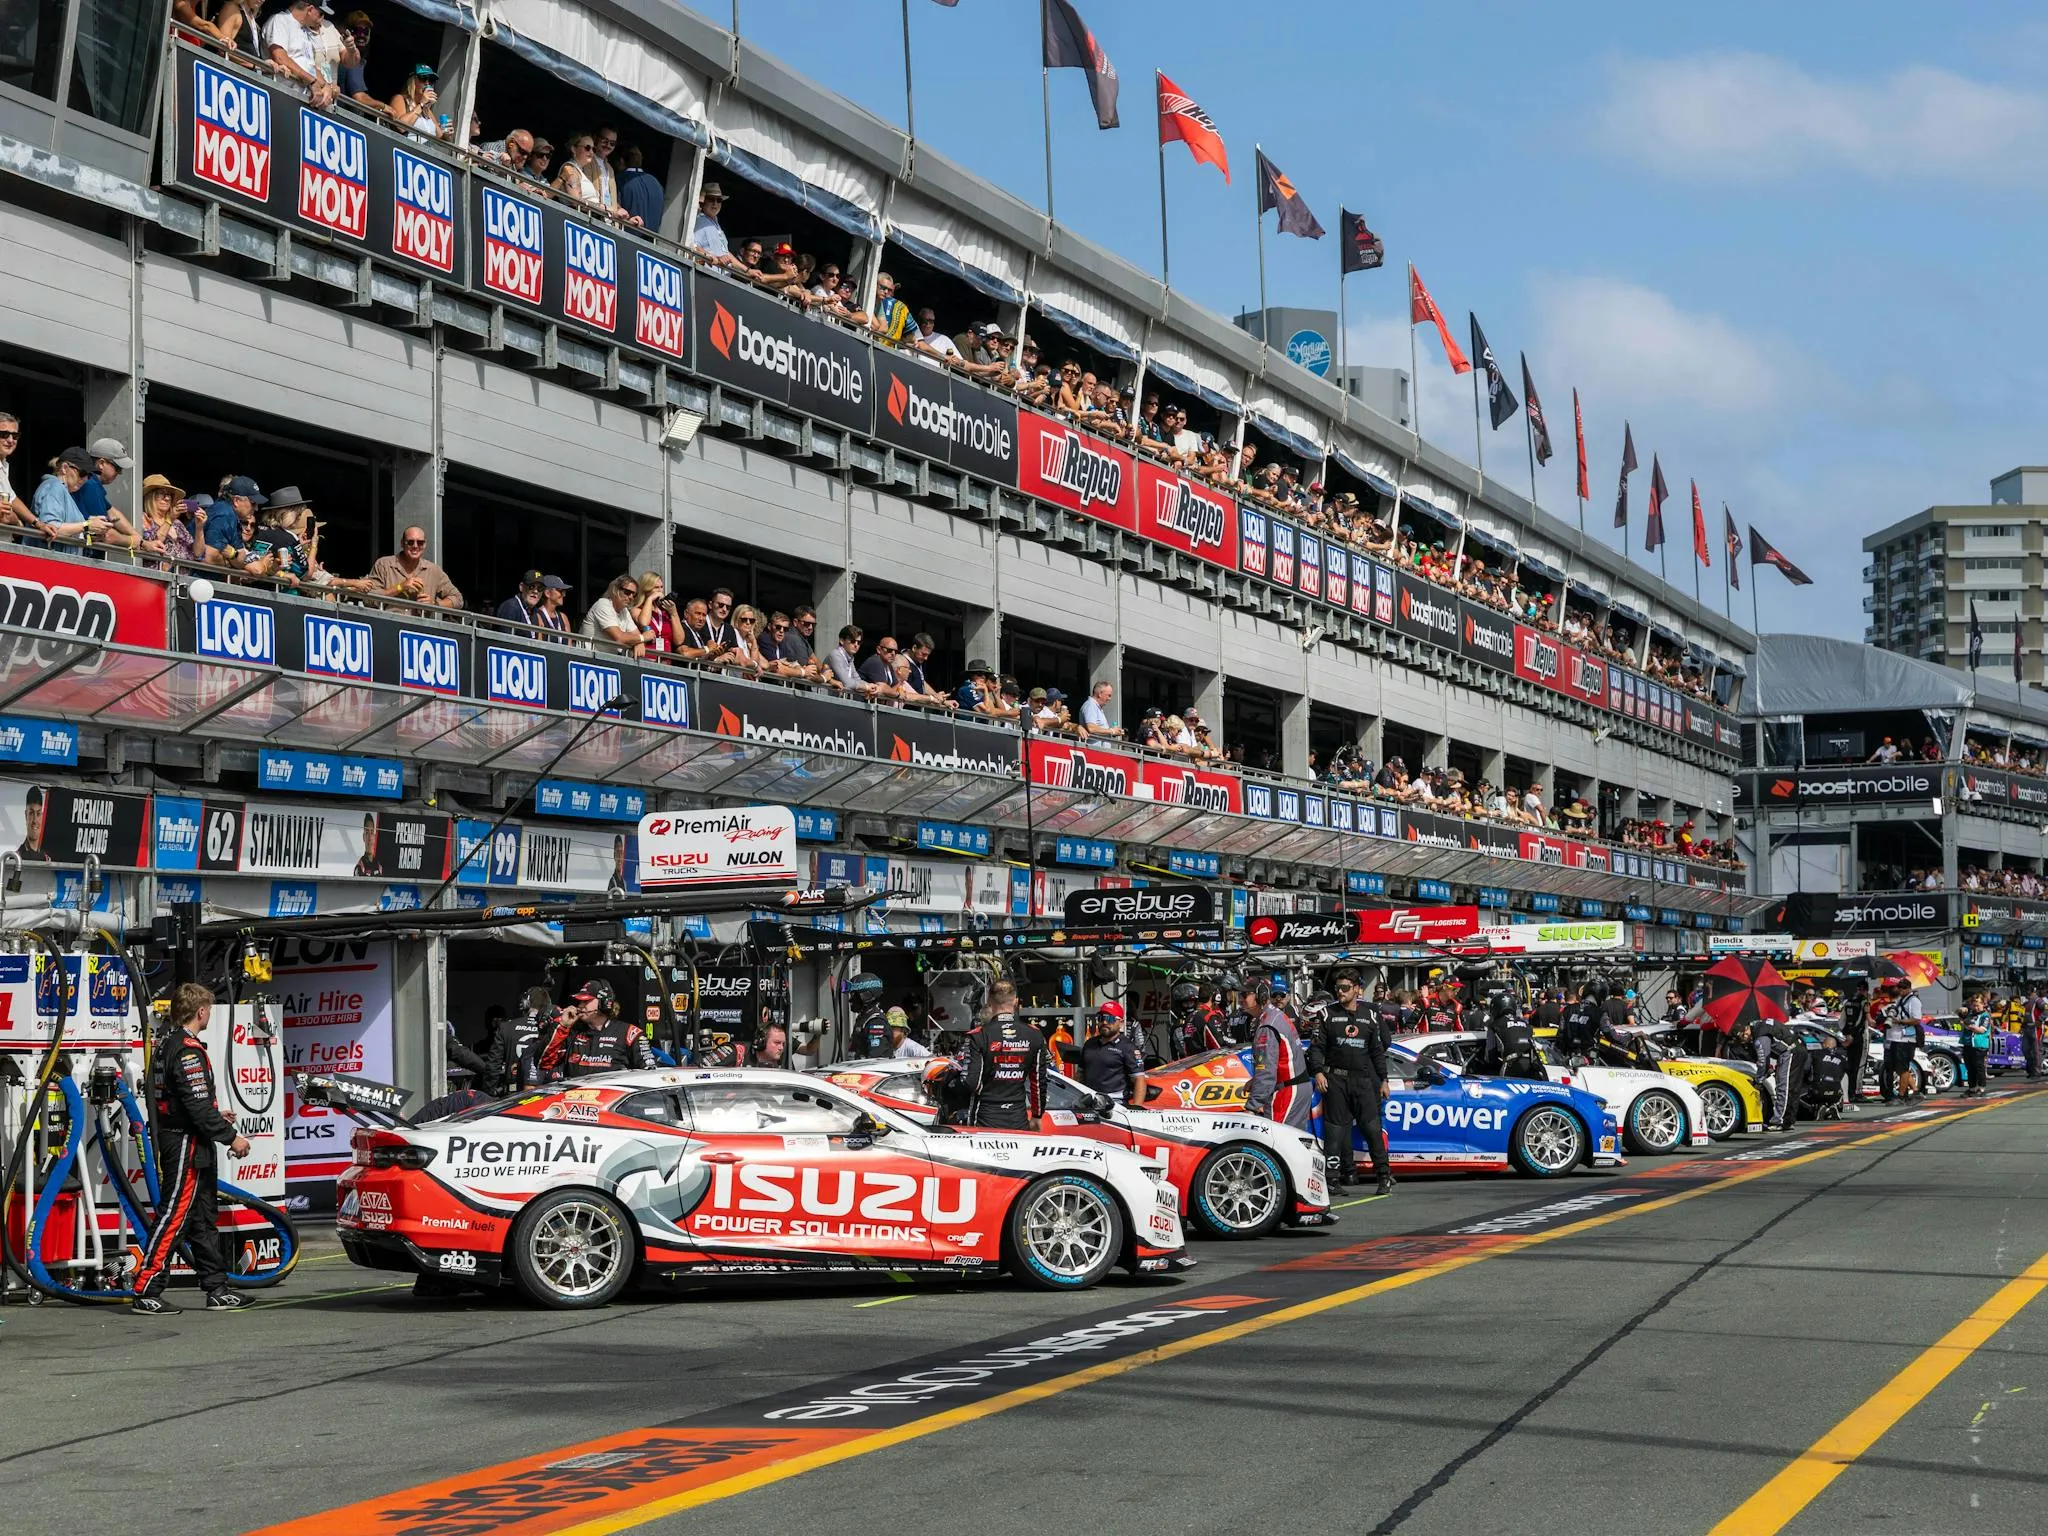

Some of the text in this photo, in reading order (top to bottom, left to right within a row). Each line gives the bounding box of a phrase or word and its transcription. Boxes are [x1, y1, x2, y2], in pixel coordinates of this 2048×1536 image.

[199, 62, 268, 140] LIQUI
[198, 125, 268, 193] MOLY
[303, 115, 365, 181] LIQUI
[397, 155, 451, 216] LIQUI
[302, 167, 365, 233] MOLY
[396, 205, 451, 266] MOLY
[486, 193, 541, 252] LIQUI
[567, 225, 615, 280] LIQUI
[486, 243, 541, 299] MOLY
[639, 256, 682, 308] LIQUI
[567, 272, 615, 327] MOLY
[639, 301, 682, 353] MOLY
[738, 315, 862, 404] boostmobile
[908, 397, 1011, 460] boostmobile
[1064, 433, 1121, 506] Repco
[1177, 480, 1224, 546] Repco
[1244, 512, 1266, 546] LIQUI
[1274, 525, 1293, 556] LIQUI
[1245, 540, 1266, 573] MOLY
[1301, 537, 1319, 566] LIQUI
[1329, 548, 1346, 576] LIQUI
[1275, 551, 1293, 584] MOLY
[1301, 562, 1319, 594] MOLY
[1353, 558, 1369, 587] LIQUI
[1329, 571, 1346, 604] MOLY
[1377, 568, 1391, 596] LIQUI
[1354, 581, 1369, 613] MOLY
[1377, 591, 1391, 622] MOLY
[1410, 594, 1456, 637] boostmobile
[201, 604, 269, 658] LIQUI
[1473, 617, 1512, 657] boostmobile
[309, 622, 368, 672] LIQUI
[1536, 634, 1557, 681] Repco
[404, 638, 456, 685] LIQUI
[1582, 654, 1602, 695] Repco
[492, 654, 543, 700] LIQUI
[572, 668, 618, 712] LIQUI
[644, 681, 686, 723] LIQUI
[42, 730, 72, 756] Thrifty
[266, 758, 293, 782] Thrifty
[306, 761, 330, 785] Thrifty
[343, 765, 366, 788] Thrifty
[378, 768, 398, 791] Thrifty
[1799, 776, 1929, 795] boostmobile
[72, 798, 113, 825] PREMIAIR
[1249, 787, 1269, 818] LIQUI
[1279, 792, 1298, 821] LIQUI
[1306, 797, 1322, 825] LIQUI
[396, 822, 426, 845] PREMIAIR
[674, 815, 751, 834] PremiAir
[1358, 807, 1374, 833] LIQUI
[1382, 810, 1396, 837] LIQUI
[76, 827, 108, 854] RACING
[159, 817, 199, 851] Thrifty
[208, 812, 235, 861] 62
[250, 813, 324, 868] STANAWAY
[724, 825, 789, 843] Racing
[398, 848, 422, 870] RACING
[495, 832, 515, 876] 99
[527, 835, 570, 883] MURRAY
[651, 850, 782, 866] ISUZU NULON
[278, 890, 312, 914] Thrifty
[801, 889, 824, 900] AIR
[1081, 892, 1195, 913] erebus
[517, 906, 534, 916] app
[1113, 909, 1192, 921] motorsport
[1968, 916, 1976, 925] H
[1281, 921, 1350, 938] Pizza Hut
[1538, 924, 1616, 942] SHURE
[36, 955, 45, 973] 31
[88, 956, 98, 974] 62
[111, 987, 127, 1000] app
[319, 991, 363, 1012] Hire
[98, 1021, 118, 1030] PremiAir
[296, 1013, 358, 1025] 1300 WE HIRE
[310, 1040, 363, 1062] Fuels
[1002, 1040, 1030, 1048] PremiAir
[301, 1063, 359, 1073] 1300 WE FUEL
[995, 1071, 1024, 1079] NULON
[1615, 1072, 1665, 1080] PROGRAMMED
[1668, 1068, 1716, 1076] Fastron
[245, 1087, 268, 1095] TRUCKS
[340, 1082, 402, 1105] SYZMIK
[349, 1094, 391, 1109] WORKWEAR
[1531, 1084, 1569, 1093] WORKWEAR
[568, 1105, 598, 1116] AIR
[1160, 1114, 1201, 1123] Luxton
[1385, 1100, 1508, 1130] epower
[241, 1117, 273, 1133] NULON
[1212, 1122, 1269, 1134] HIFLEX
[446, 1134, 603, 1165] PremiAir
[969, 1139, 1019, 1150] Luxton
[1032, 1146, 1104, 1161] HIFLEX
[237, 1163, 277, 1180] HIFLEX
[454, 1165, 549, 1179] 1300 WE HIRE
[713, 1162, 977, 1225] ISUZU
[1156, 1189, 1176, 1208] NULON
[361, 1212, 392, 1224] ISUZU
[422, 1216, 495, 1232] PremiAir fuels
[694, 1213, 784, 1235] POWER
[788, 1219, 927, 1242] SOLUTIONS
[1150, 1215, 1173, 1232] ISUZU
[258, 1238, 279, 1259] AIR
[1154, 1233, 1170, 1242] TRUCKS
[440, 1251, 476, 1269] gbb
[955, 1256, 982, 1265] Repco
[764, 1310, 1228, 1420] boostmobile
[514, 1437, 800, 1506] WORKS
[376, 1483, 544, 1522] OFF
